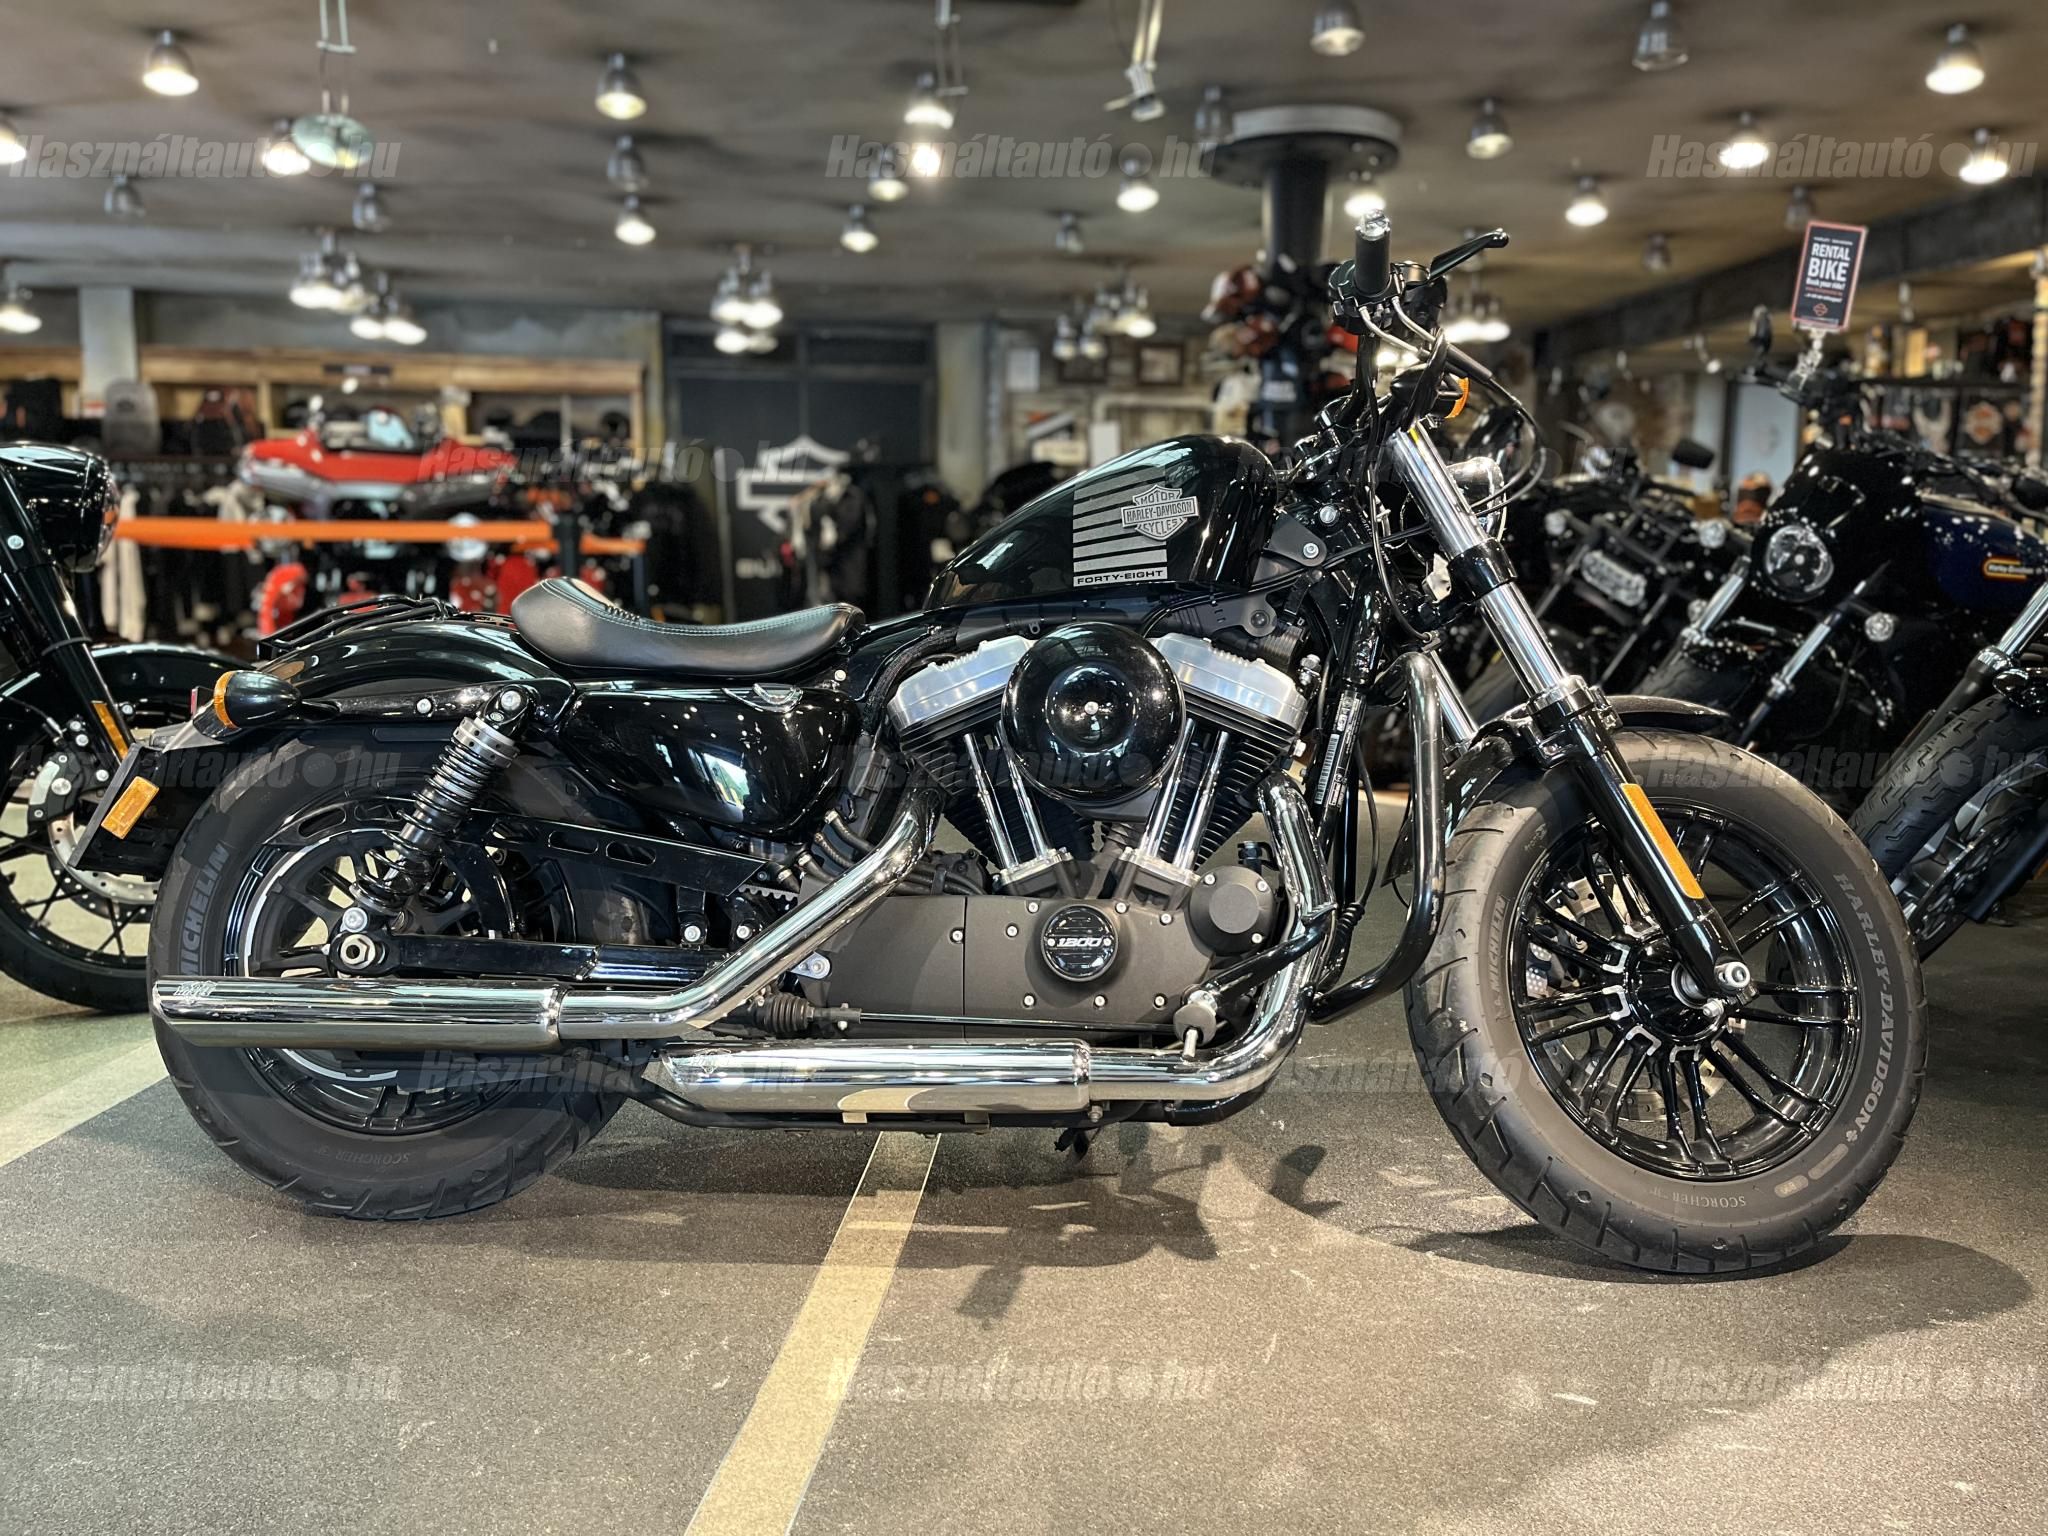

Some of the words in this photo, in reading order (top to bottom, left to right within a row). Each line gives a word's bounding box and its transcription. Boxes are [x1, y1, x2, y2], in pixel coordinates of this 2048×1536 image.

[1811, 243, 1851, 261] RENTAL
[1807, 258, 1849, 282] BIKE
[1141, 491, 1177, 505] MOTOR
[1126, 501, 1193, 522] HARLEY-DAVIDSON
[1143, 518, 1178, 535] CYCLES
[1077, 570, 1164, 585] FORTY-EIGHT
[1487, 894, 1509, 992] MICHELIN
[1833, 872, 1895, 1133] HARLEY-DAVIDSON
[1672, 1191, 1746, 1208] SCORCHER
